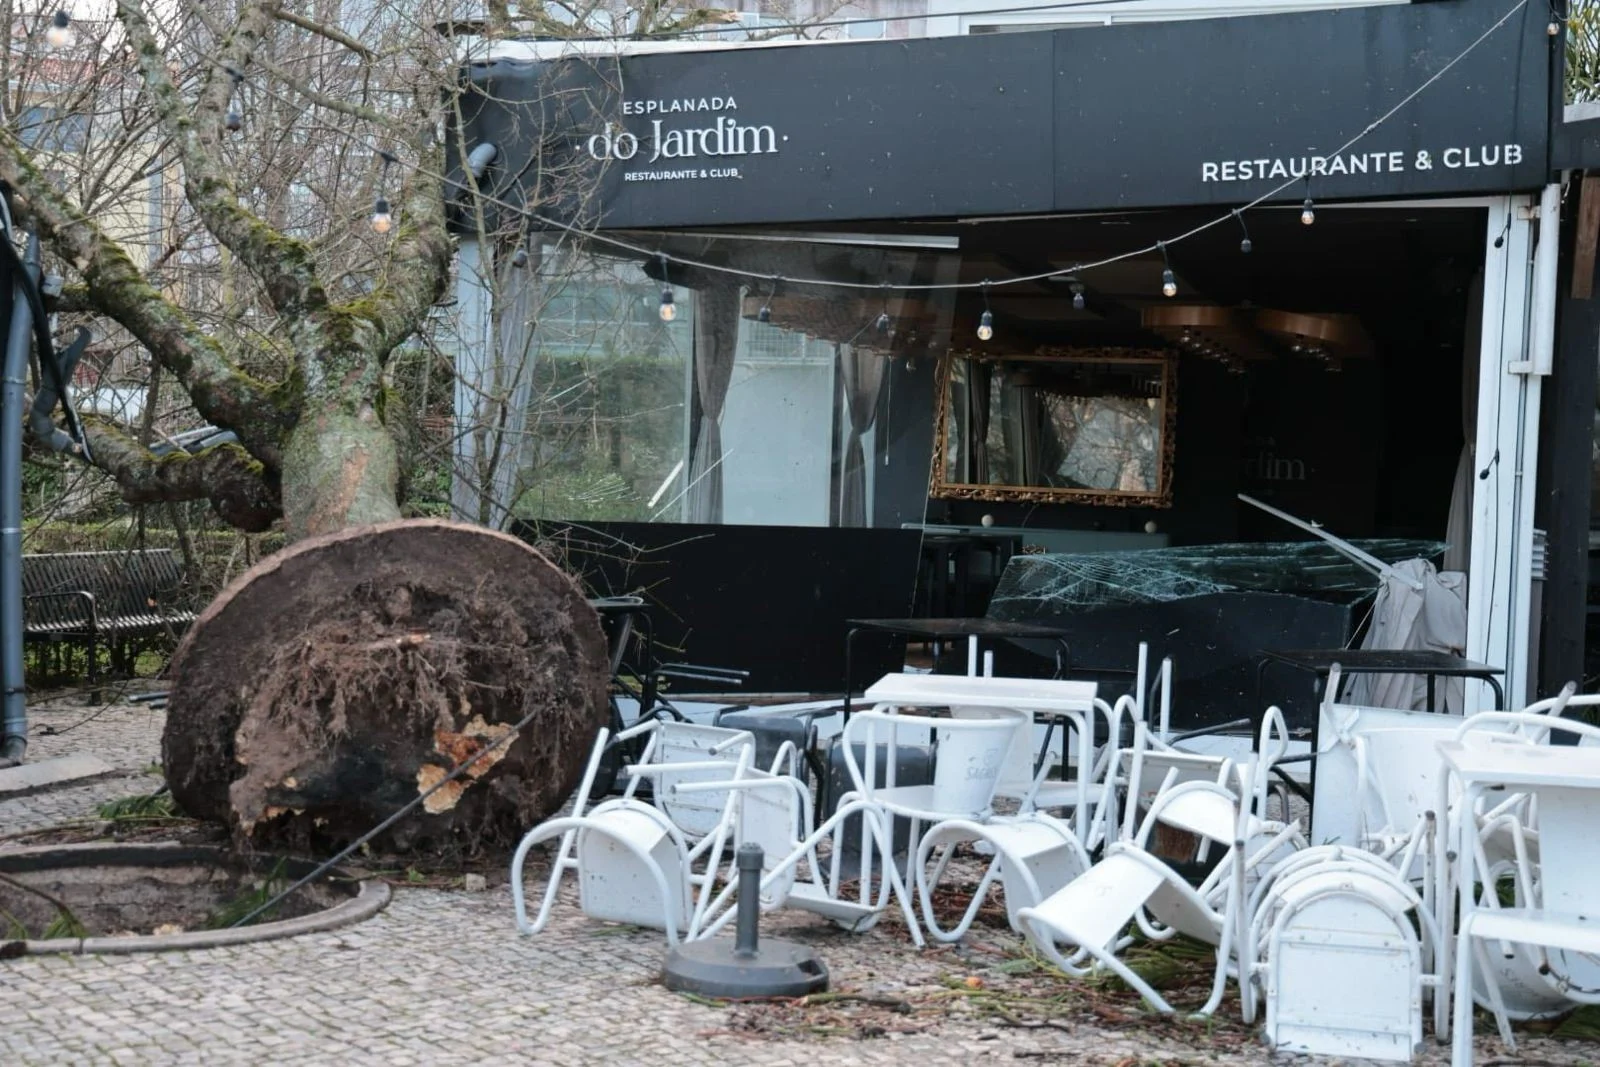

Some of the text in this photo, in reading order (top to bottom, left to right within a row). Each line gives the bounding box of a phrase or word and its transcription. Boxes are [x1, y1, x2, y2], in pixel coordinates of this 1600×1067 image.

[623, 96, 737, 115] ESPLANADA
[588, 116, 778, 163] do Jardim
[624, 168, 738, 182] RESTAURANTE & CLUB
[1202, 144, 1523, 182] RESTAURANTE & CLUB
